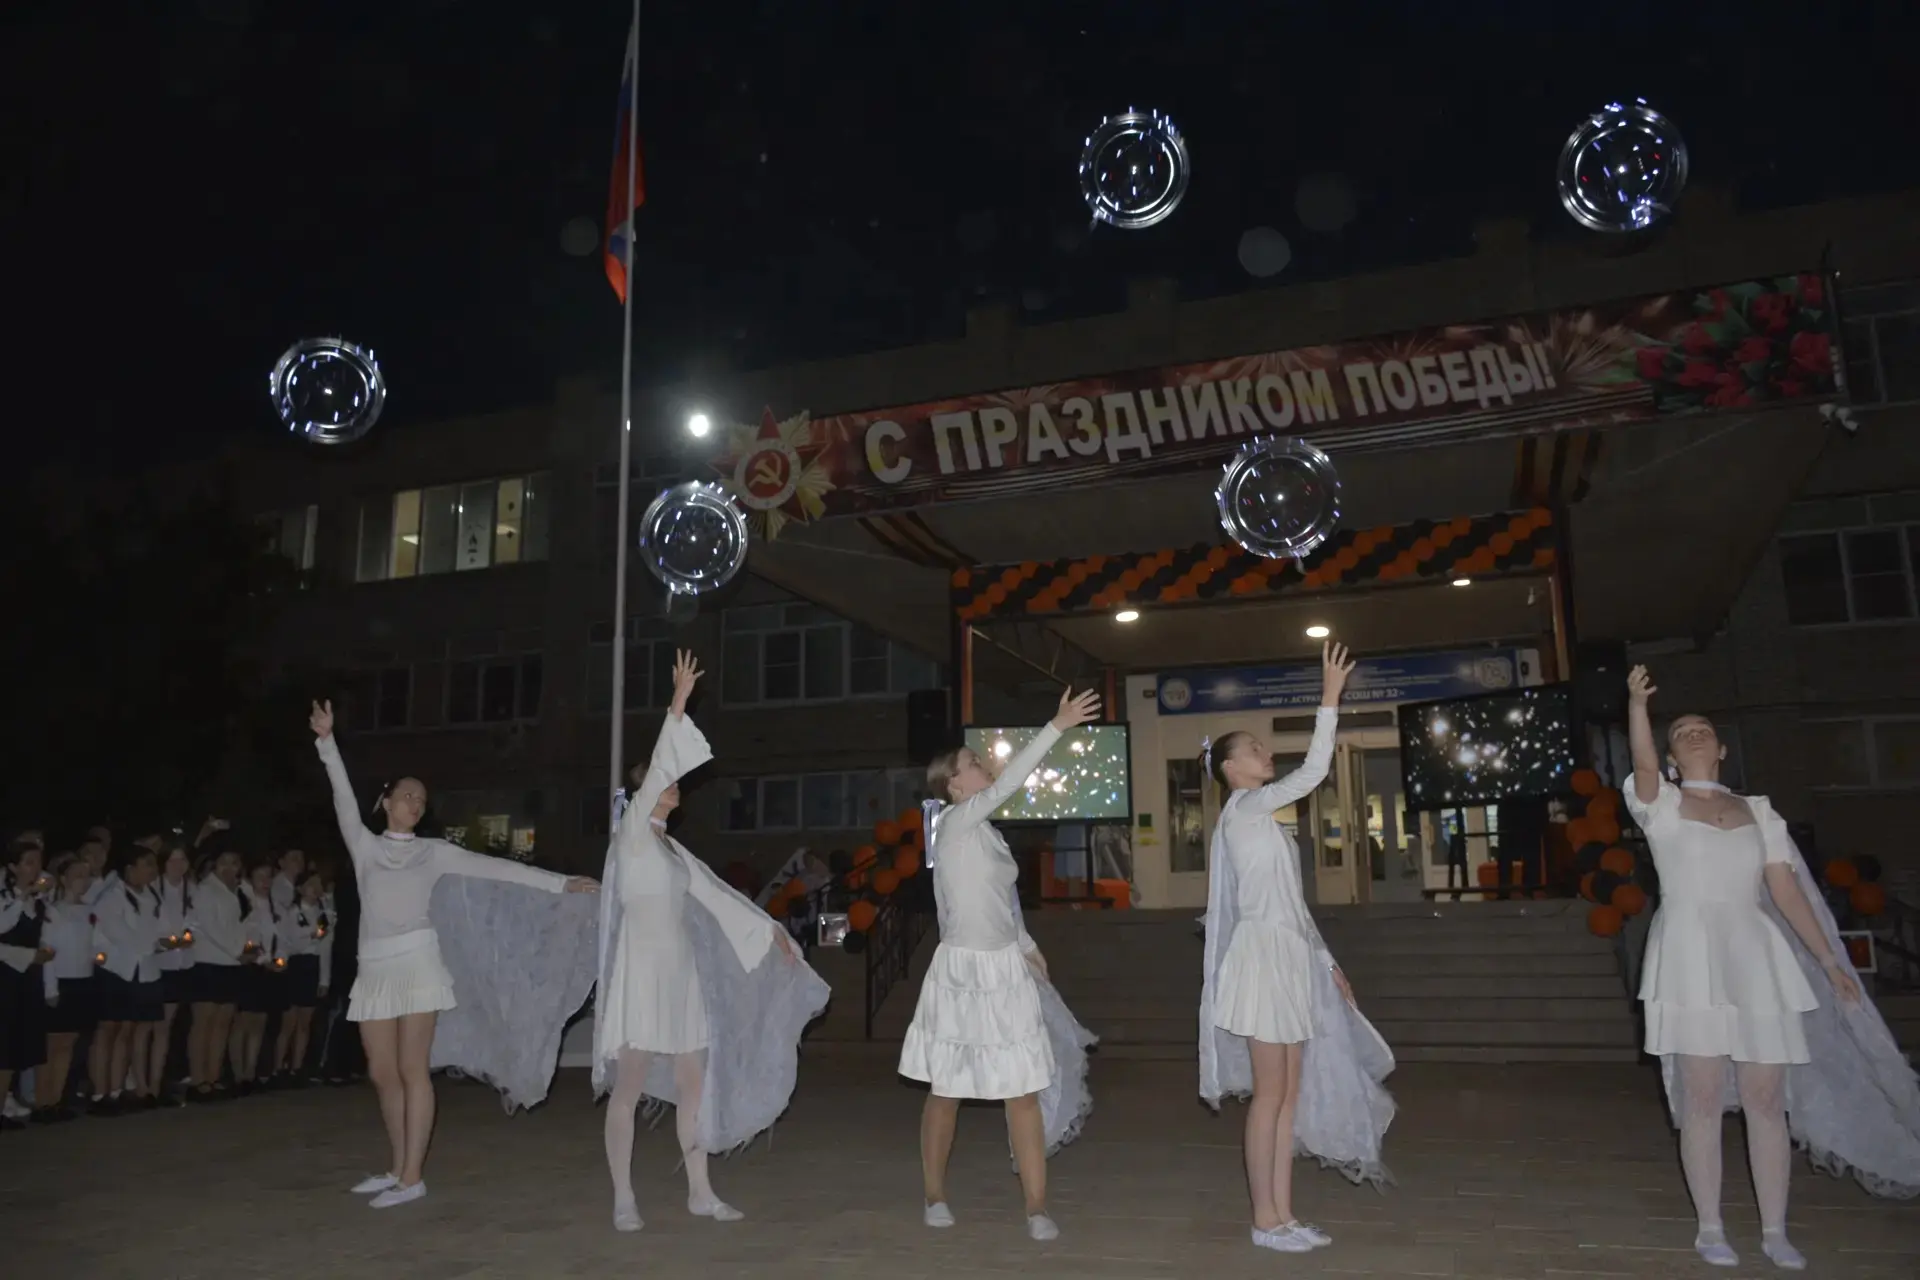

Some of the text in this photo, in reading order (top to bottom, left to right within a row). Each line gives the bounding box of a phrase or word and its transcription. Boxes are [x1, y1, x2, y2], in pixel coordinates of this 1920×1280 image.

[863, 343, 1555, 484] С ПРАЗДНИКОМ ПОБЕДЫ!
